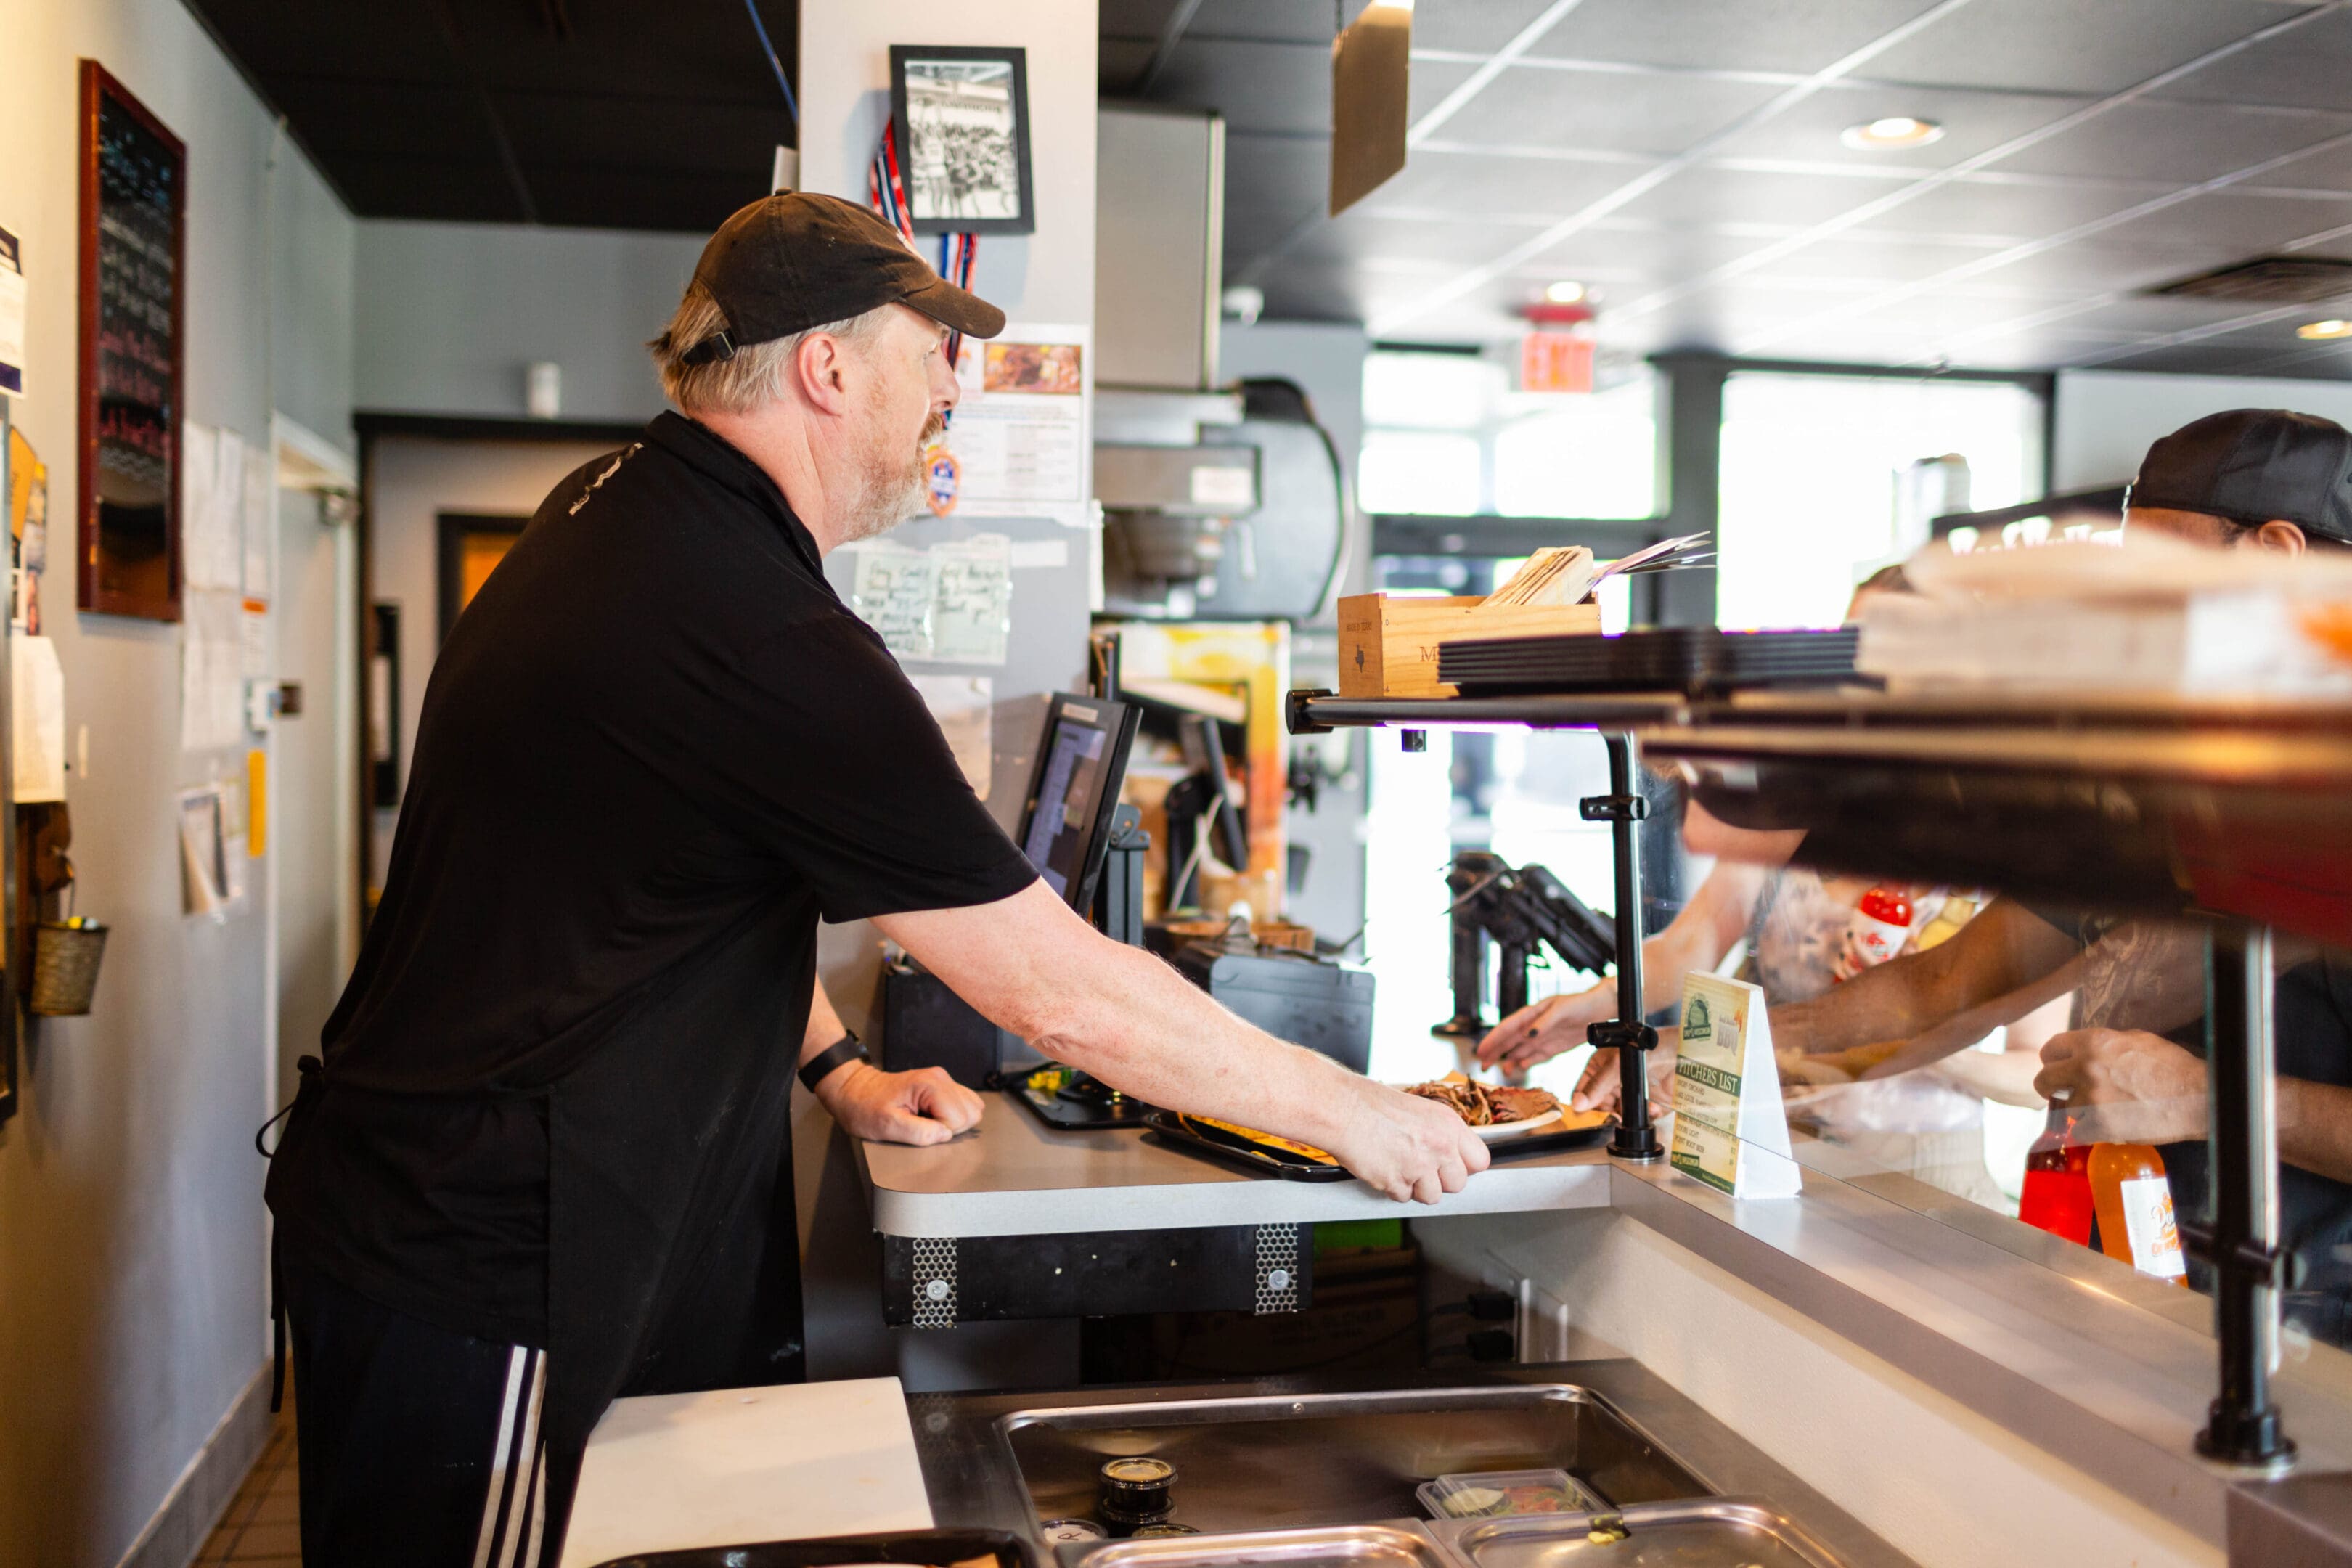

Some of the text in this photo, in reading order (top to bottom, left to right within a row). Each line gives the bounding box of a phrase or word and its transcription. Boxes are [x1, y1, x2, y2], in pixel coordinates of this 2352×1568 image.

[1717, 1024, 1738, 1056] BBQ
[1678, 1058, 1738, 1093] PITCHERS LIST
